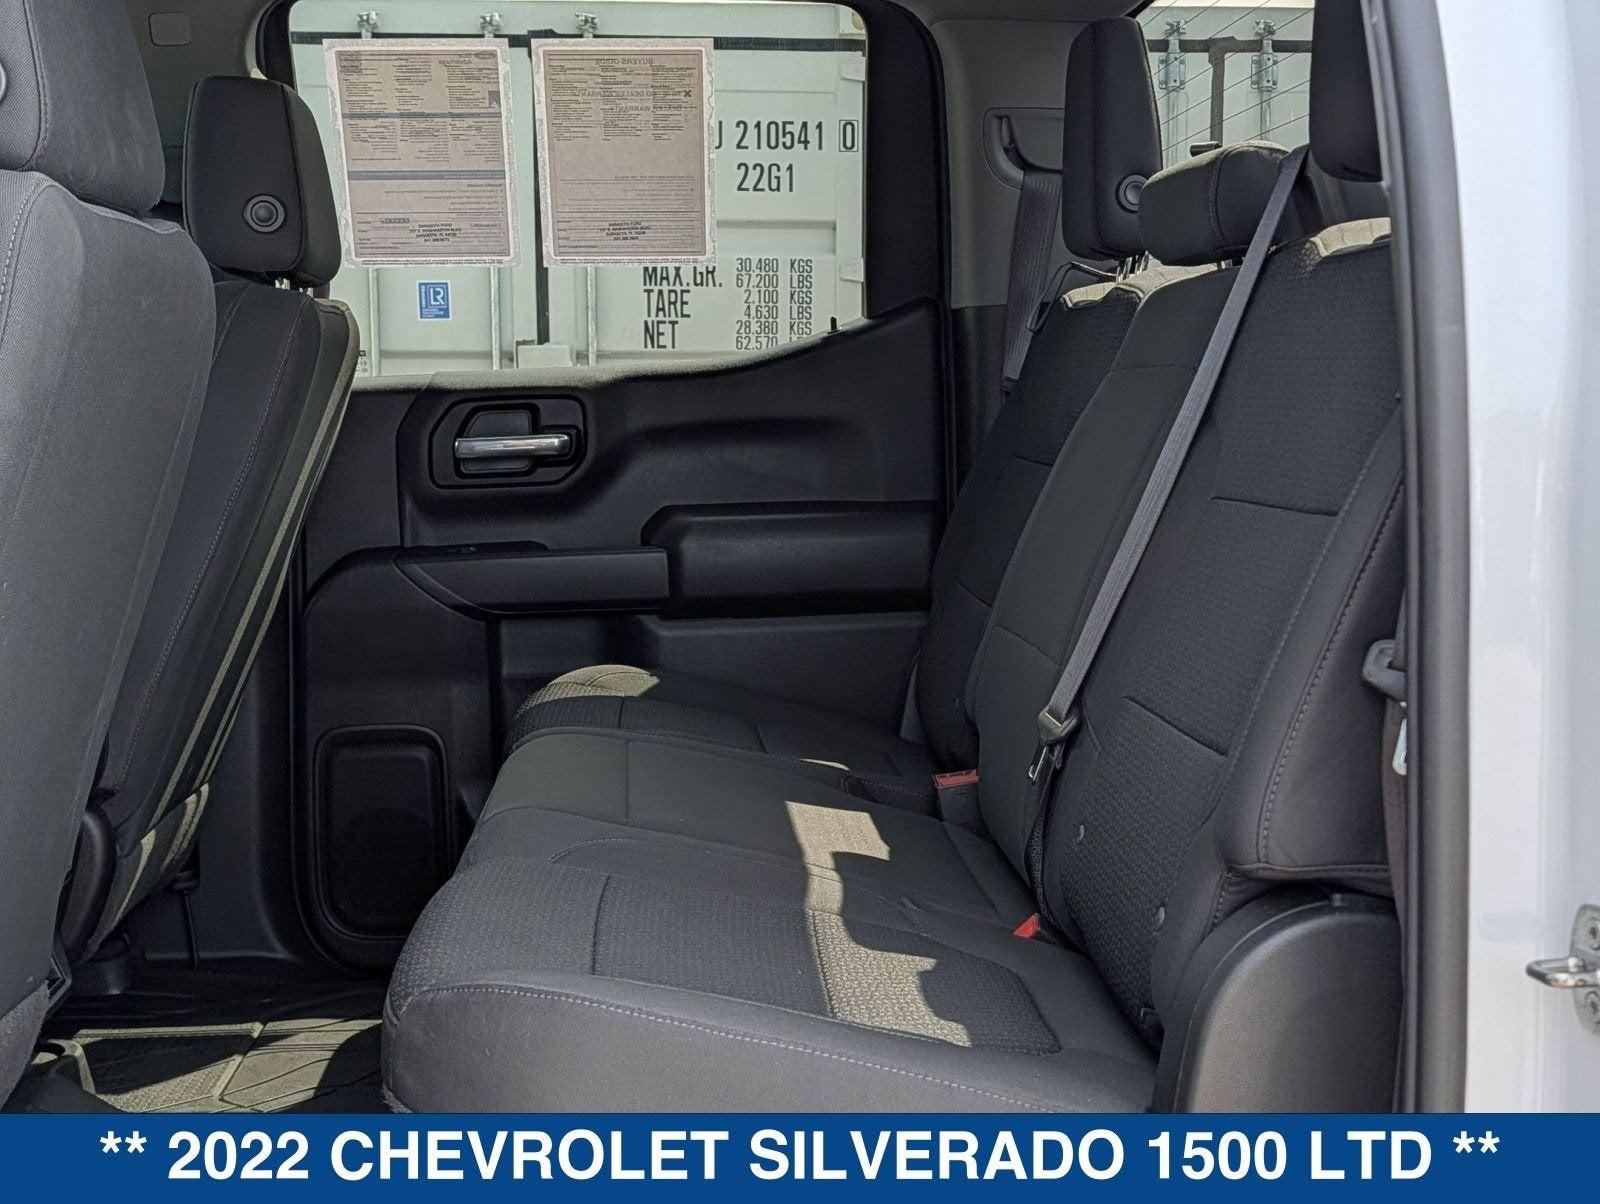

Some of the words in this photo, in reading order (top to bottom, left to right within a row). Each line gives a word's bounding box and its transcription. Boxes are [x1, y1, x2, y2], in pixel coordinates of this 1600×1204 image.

[735, 120, 823, 151] 210541
[736, 162, 794, 193] 22G1
[736, 257, 779, 273] 30.480
[789, 258, 813, 273] KGS
[736, 273, 779, 289] 67.200
[789, 274, 813, 289] LBS
[643, 289, 692, 318] TARE
[744, 289, 779, 304] 2.100
[789, 290, 813, 304] KGS
[744, 305, 779, 320] 4.630
[789, 306, 813, 320] LBS
[643, 320, 679, 349] NET
[736, 320, 779, 335] 28.380
[789, 321, 813, 335] KGS
[735, 336, 778, 351] 62.570
